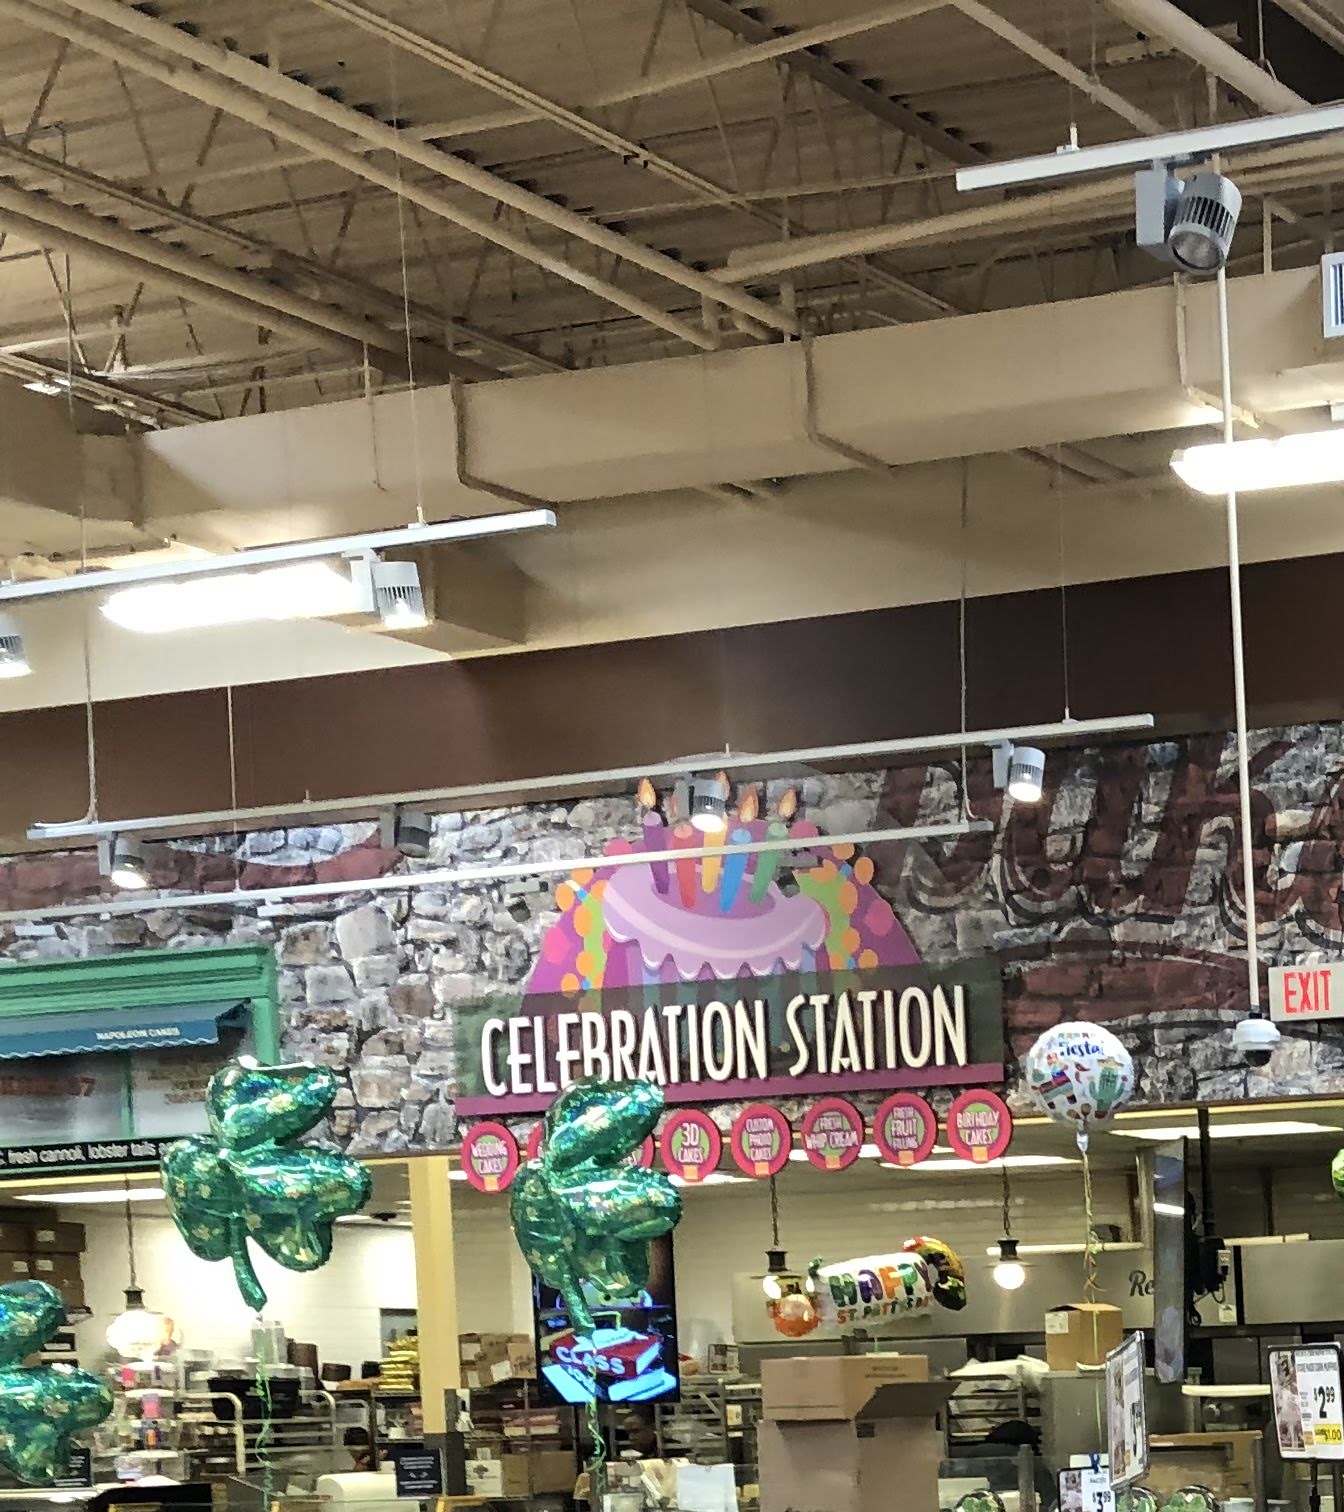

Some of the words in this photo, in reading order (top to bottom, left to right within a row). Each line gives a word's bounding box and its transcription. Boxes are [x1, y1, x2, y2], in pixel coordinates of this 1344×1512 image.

[1283, 969, 1332, 1014] EXIT
[480, 1000, 768, 1098] CELEBRATION
[785, 984, 967, 1078] STATION
[890, 1118, 917, 1136] FRUIT
[956, 1110, 1000, 1129] BIRTHDAY
[682, 1122, 699, 1146] 3D
[829, 1131, 858, 1149] CREAM
[964, 1129, 993, 1146] CAKES
[8, 1150, 38, 1166] fresh
[88, 1143, 129, 1160] lobster
[130, 1141, 157, 1158] tails
[677, 1147, 703, 1164] CAKES
[478, 1156, 503, 1174] CAKES
[829, 1259, 932, 1308] HAPPY
[556, 1346, 625, 1375] CLASS
